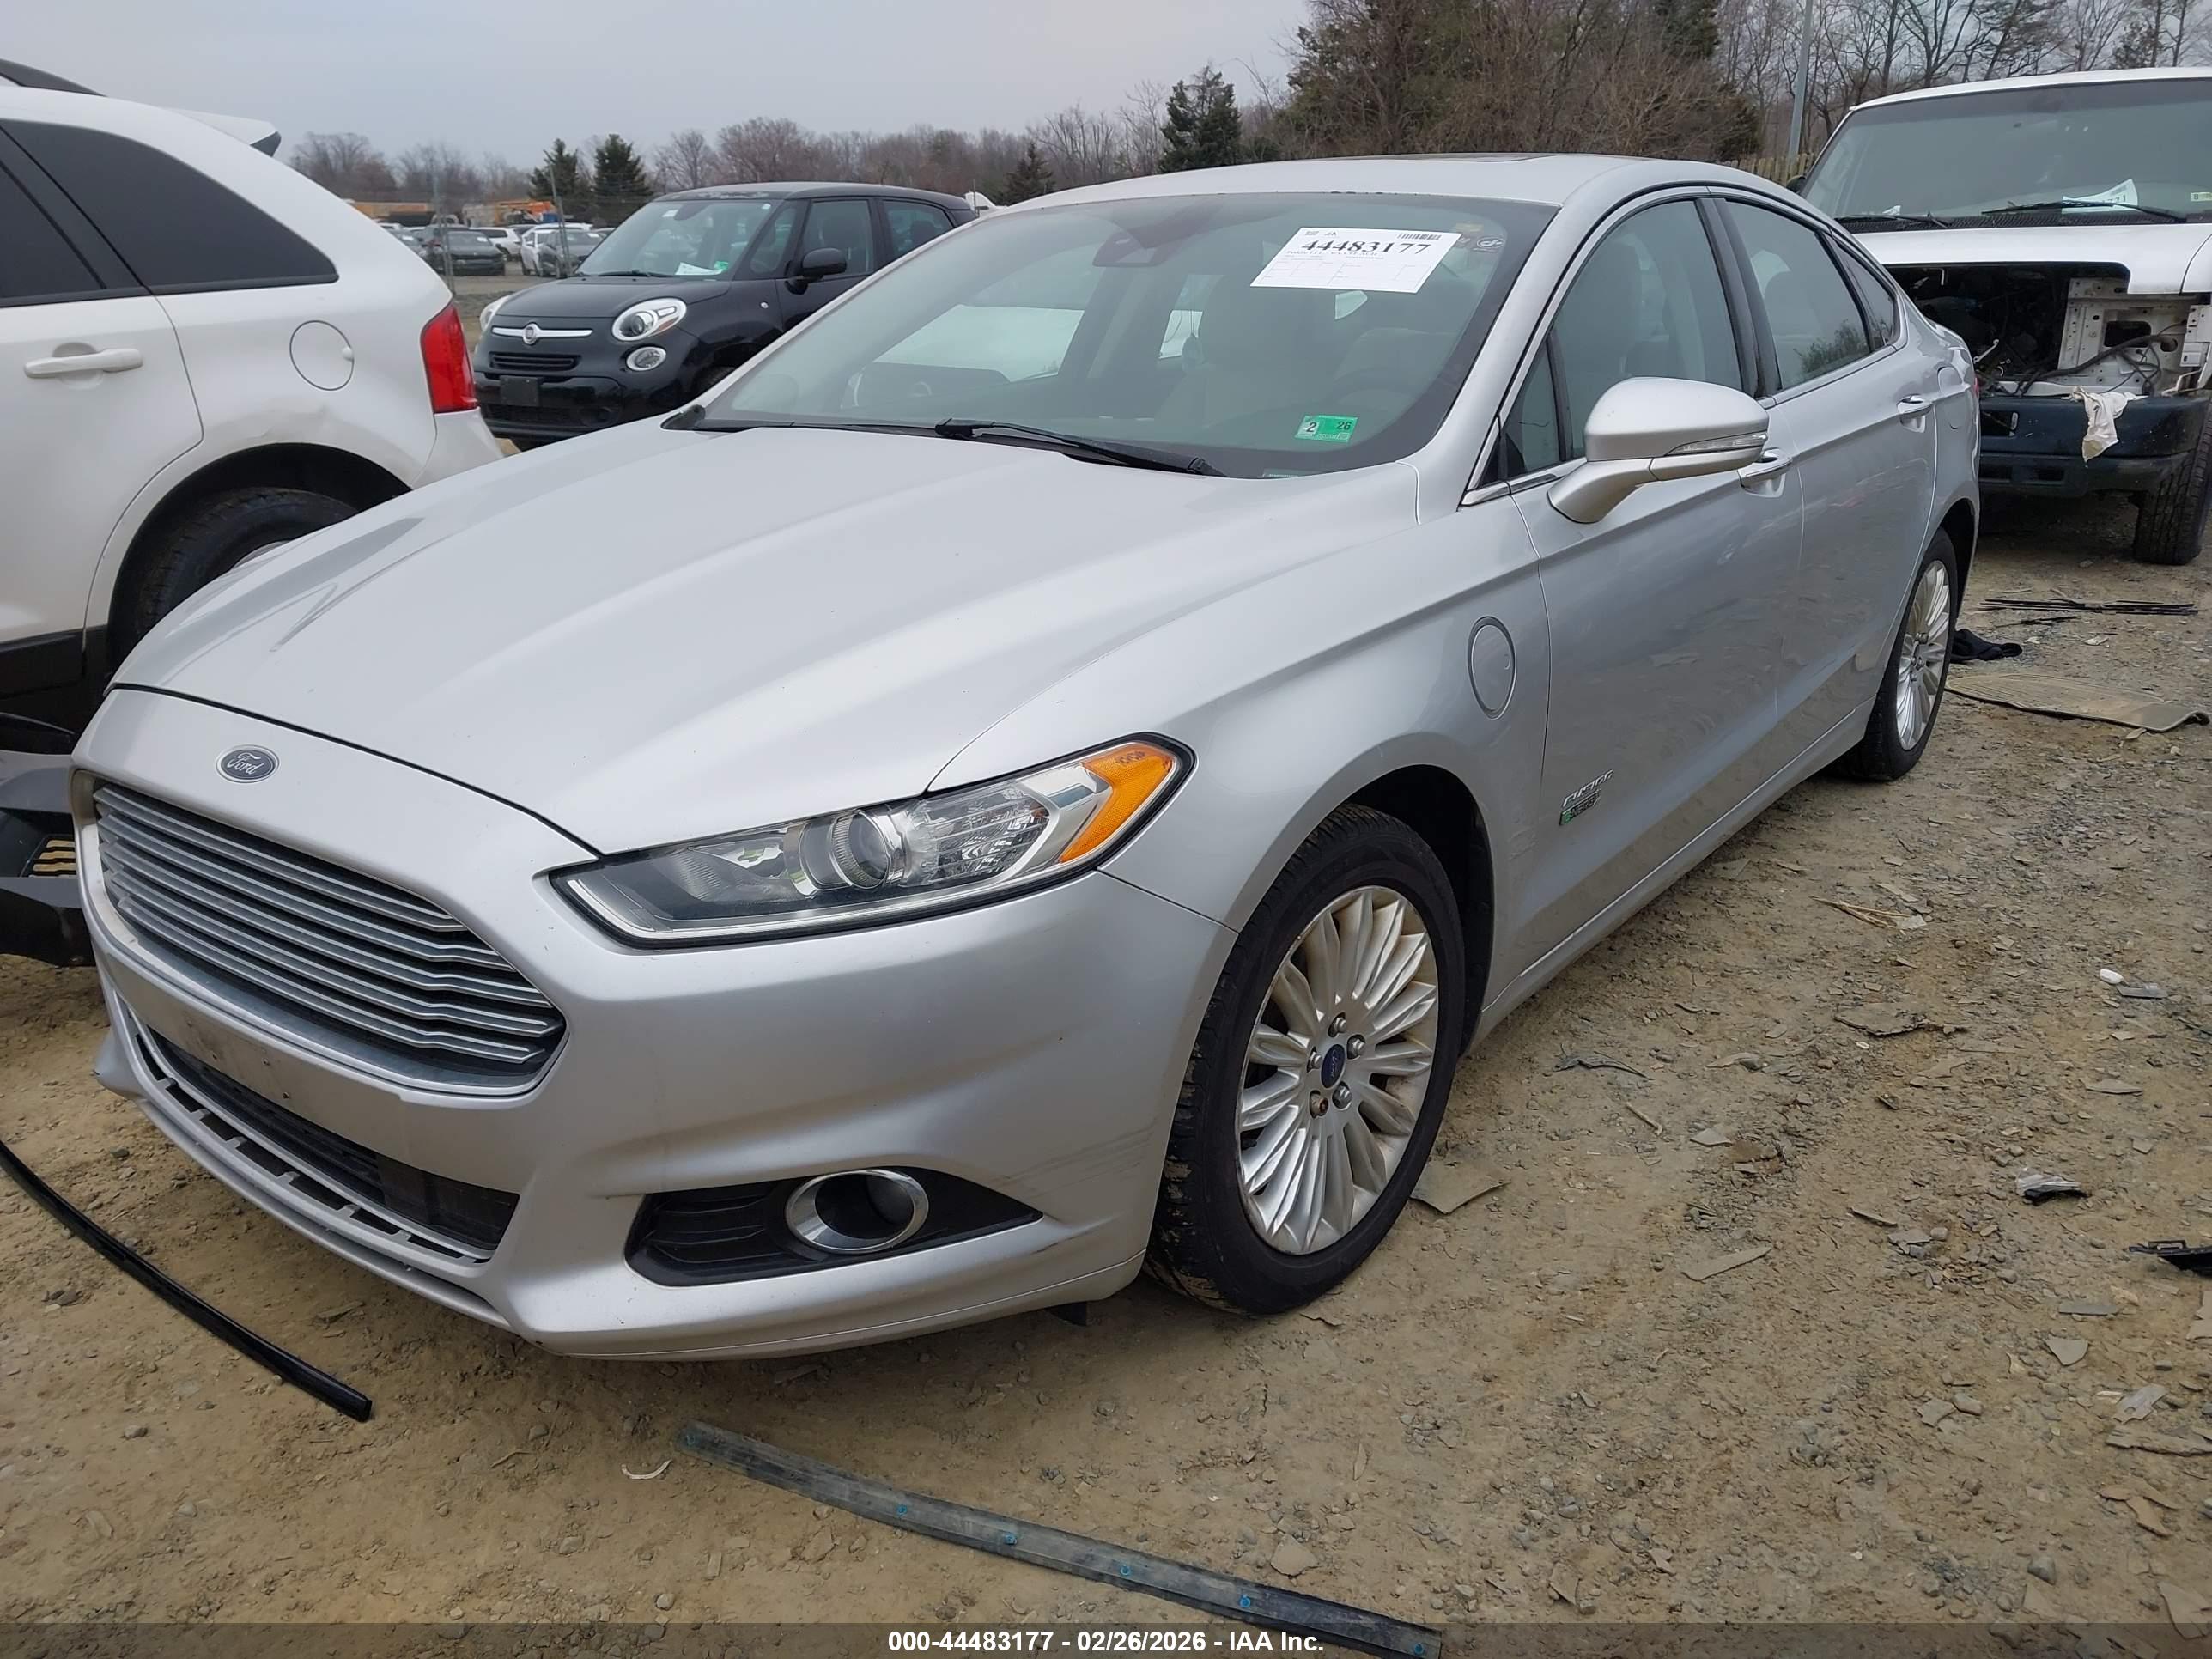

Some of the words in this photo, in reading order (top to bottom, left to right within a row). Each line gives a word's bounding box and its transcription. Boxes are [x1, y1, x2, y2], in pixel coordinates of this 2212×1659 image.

[1302, 240, 1431, 254] 44483177
[1306, 422, 1317, 433] 2
[1337, 421, 1352, 431] 26
[227, 752, 264, 775] Ford
